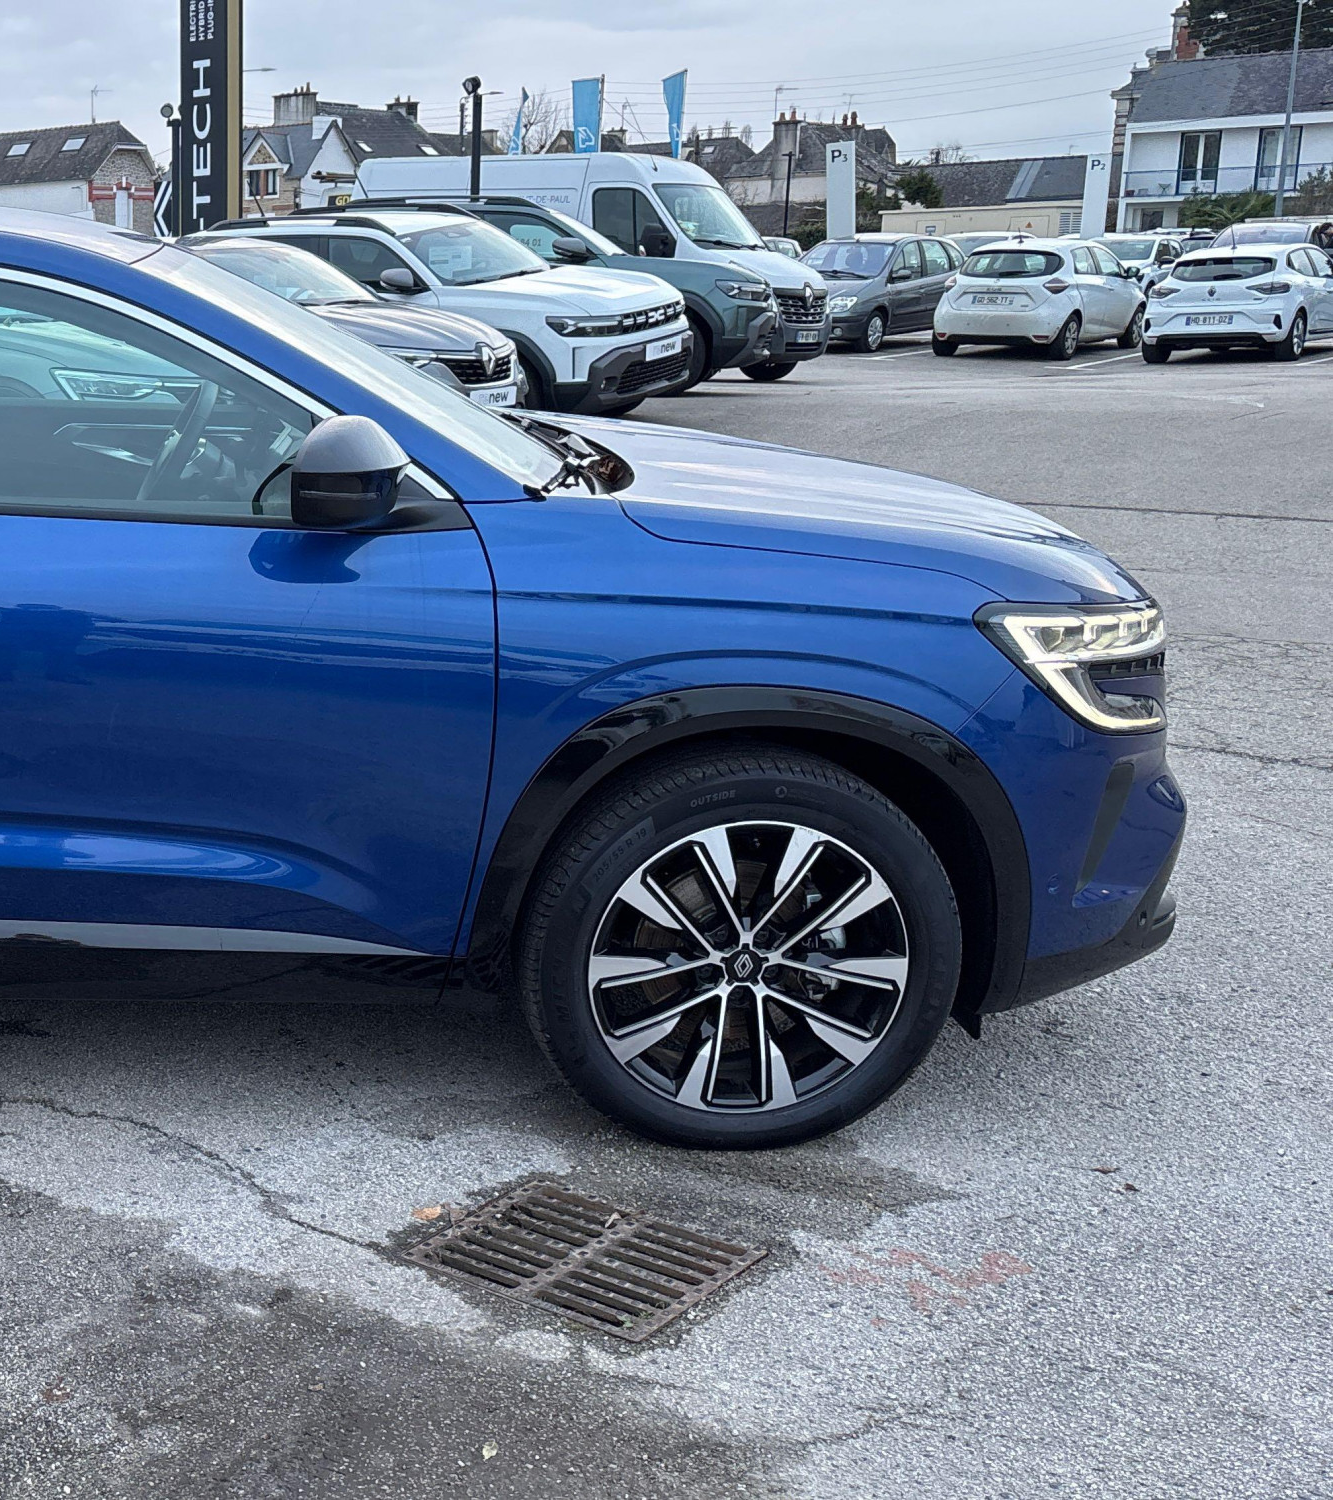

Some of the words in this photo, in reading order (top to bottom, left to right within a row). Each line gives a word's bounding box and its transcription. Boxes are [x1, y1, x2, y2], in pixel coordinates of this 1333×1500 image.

[831, 149, 848, 163] P3
[1091, 159, 1106, 171] P2
[690, 789, 736, 808] OUTSIDE
